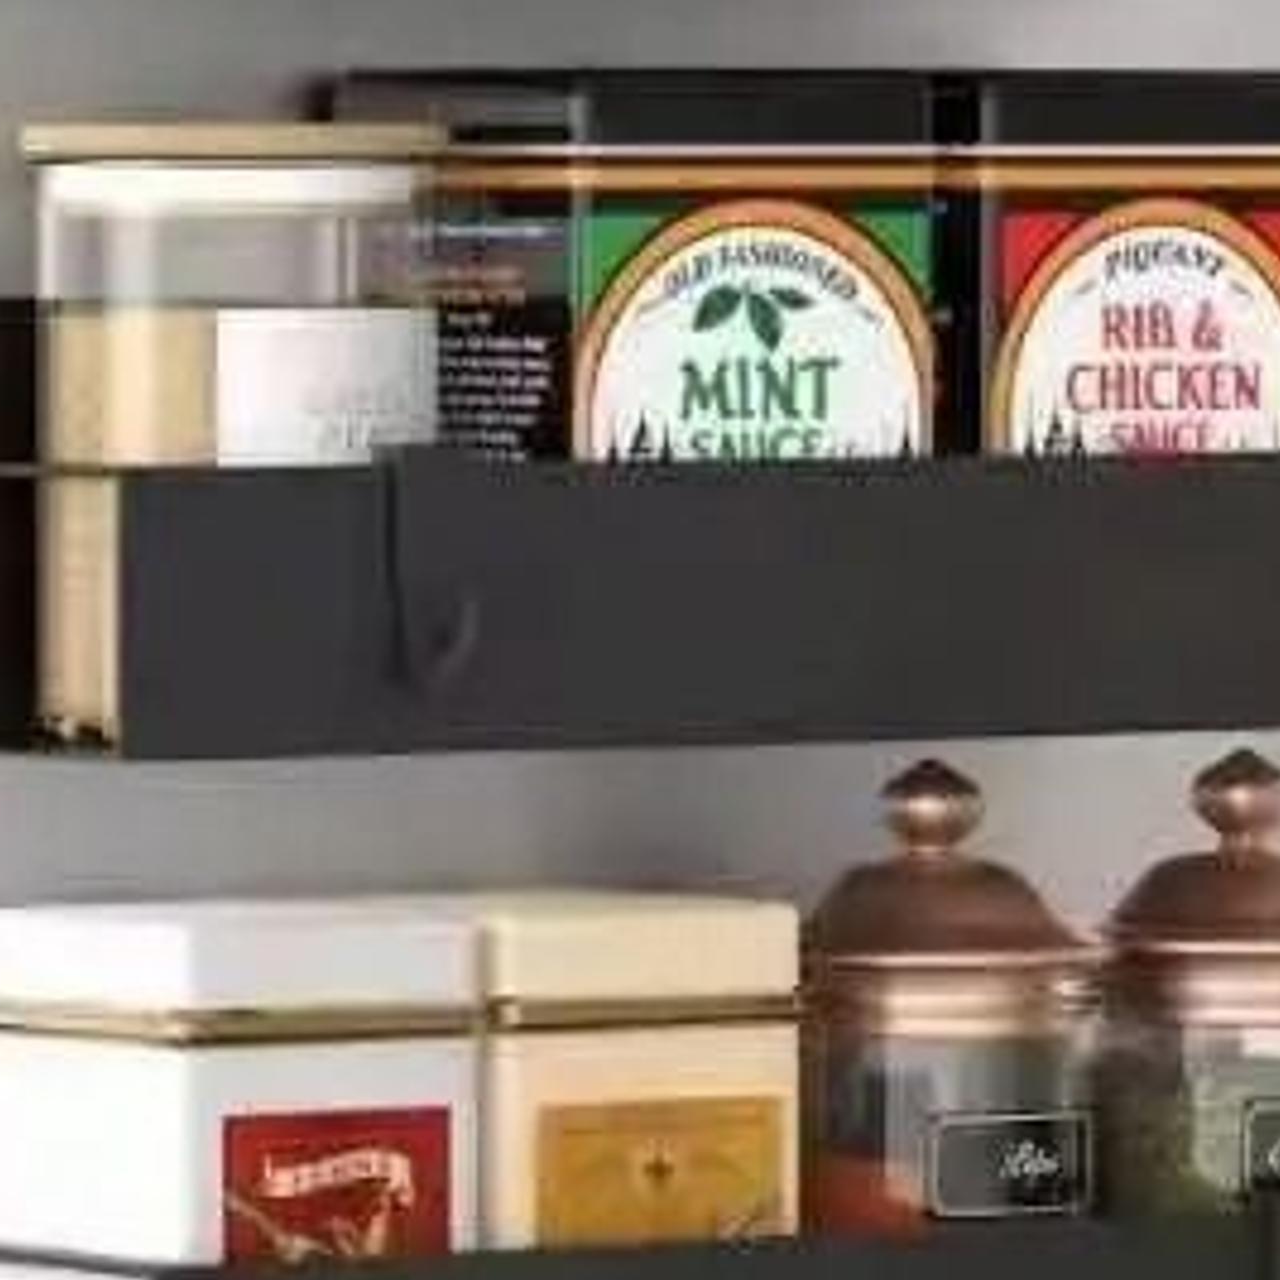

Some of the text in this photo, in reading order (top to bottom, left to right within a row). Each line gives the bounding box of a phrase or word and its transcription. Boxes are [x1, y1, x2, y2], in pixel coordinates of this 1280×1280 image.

[664, 242, 858, 301] OLD FASHIONED
[1101, 299, 1224, 352] RIB &
[679, 356, 840, 421] MINT
[1066, 362, 1262, 414] CHICKEN
